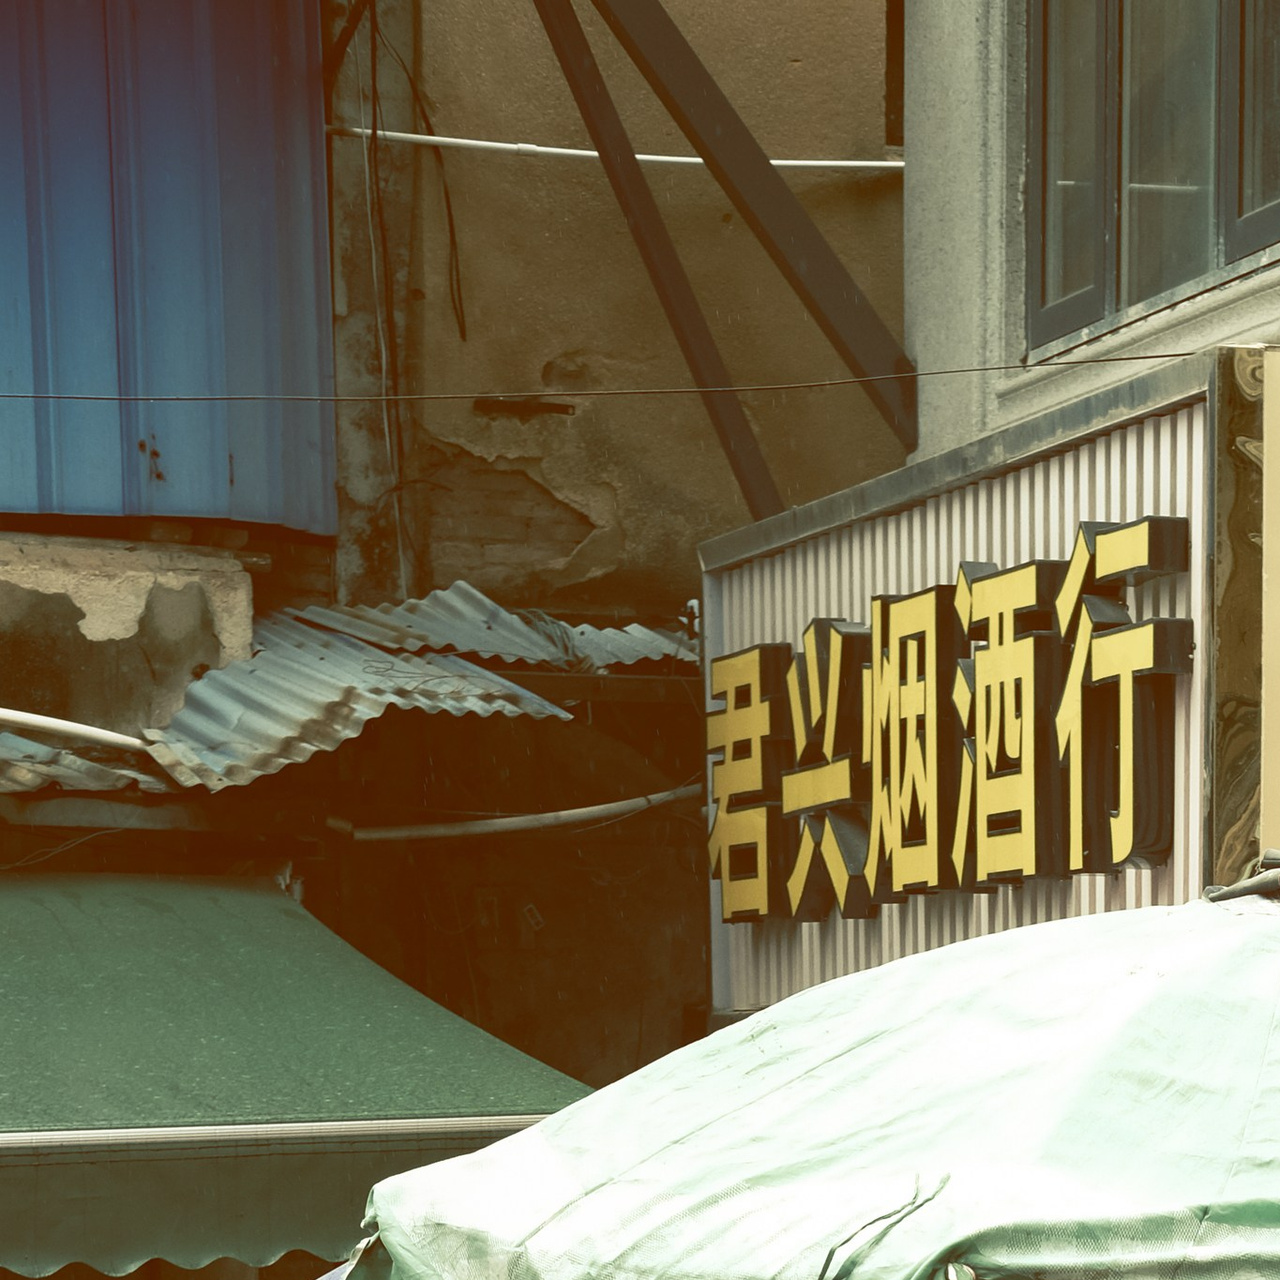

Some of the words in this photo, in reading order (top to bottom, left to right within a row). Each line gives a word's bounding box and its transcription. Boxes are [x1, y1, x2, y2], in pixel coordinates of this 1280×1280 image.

[706, 516, 1192, 923] 君兴烟酒行
